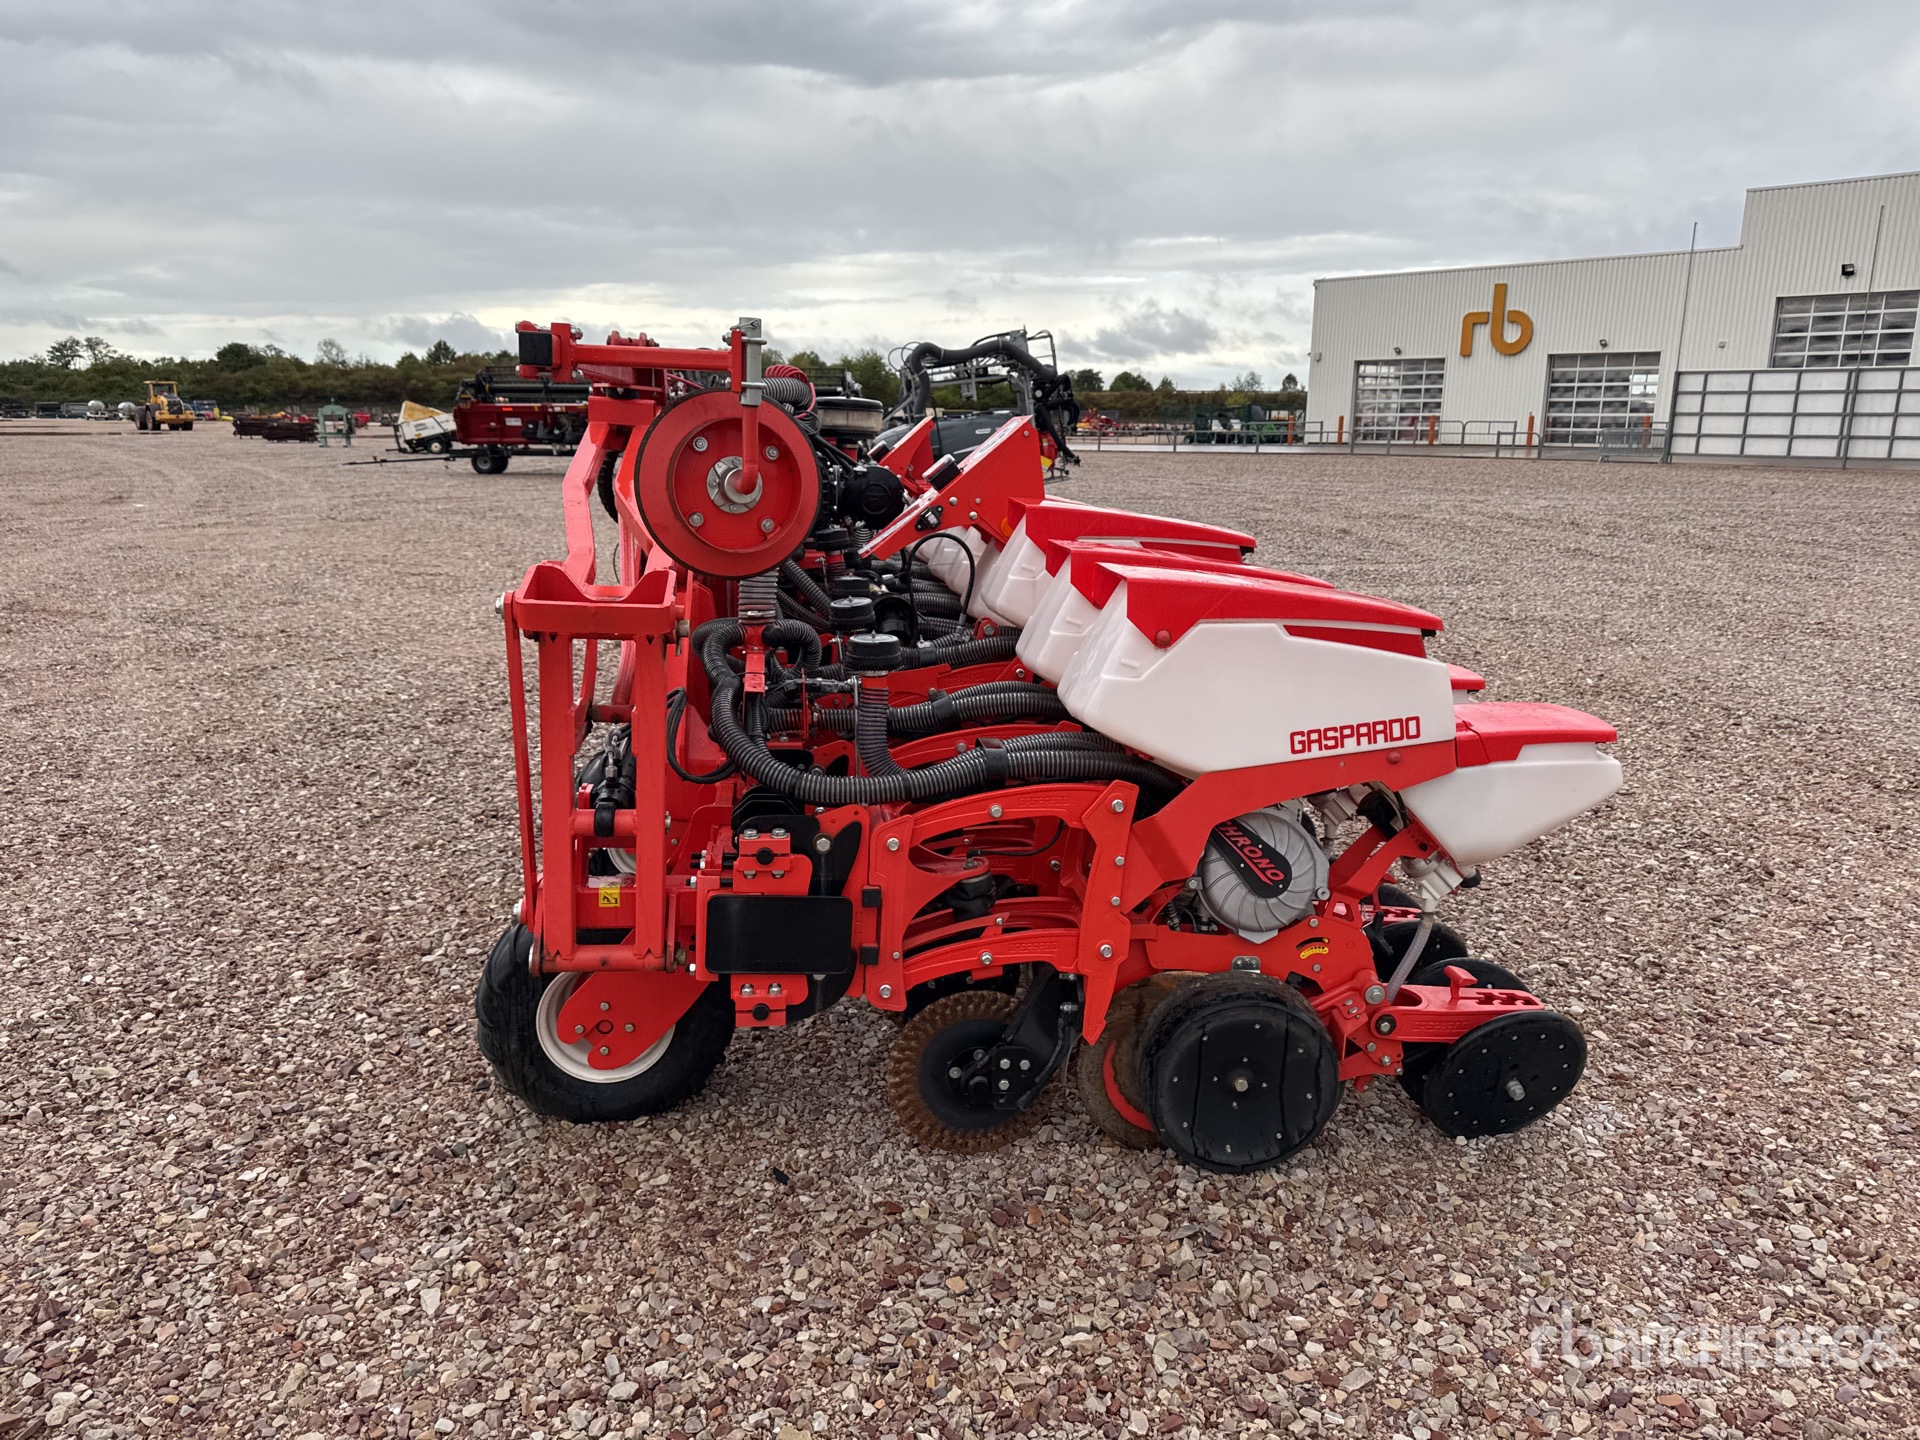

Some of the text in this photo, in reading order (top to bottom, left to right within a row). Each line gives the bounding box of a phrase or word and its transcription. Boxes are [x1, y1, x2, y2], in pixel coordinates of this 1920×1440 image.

[1460, 283, 1534, 357] rb
[1290, 716, 1421, 755] GASPARDO
[1219, 820, 1285, 881] HRONO
